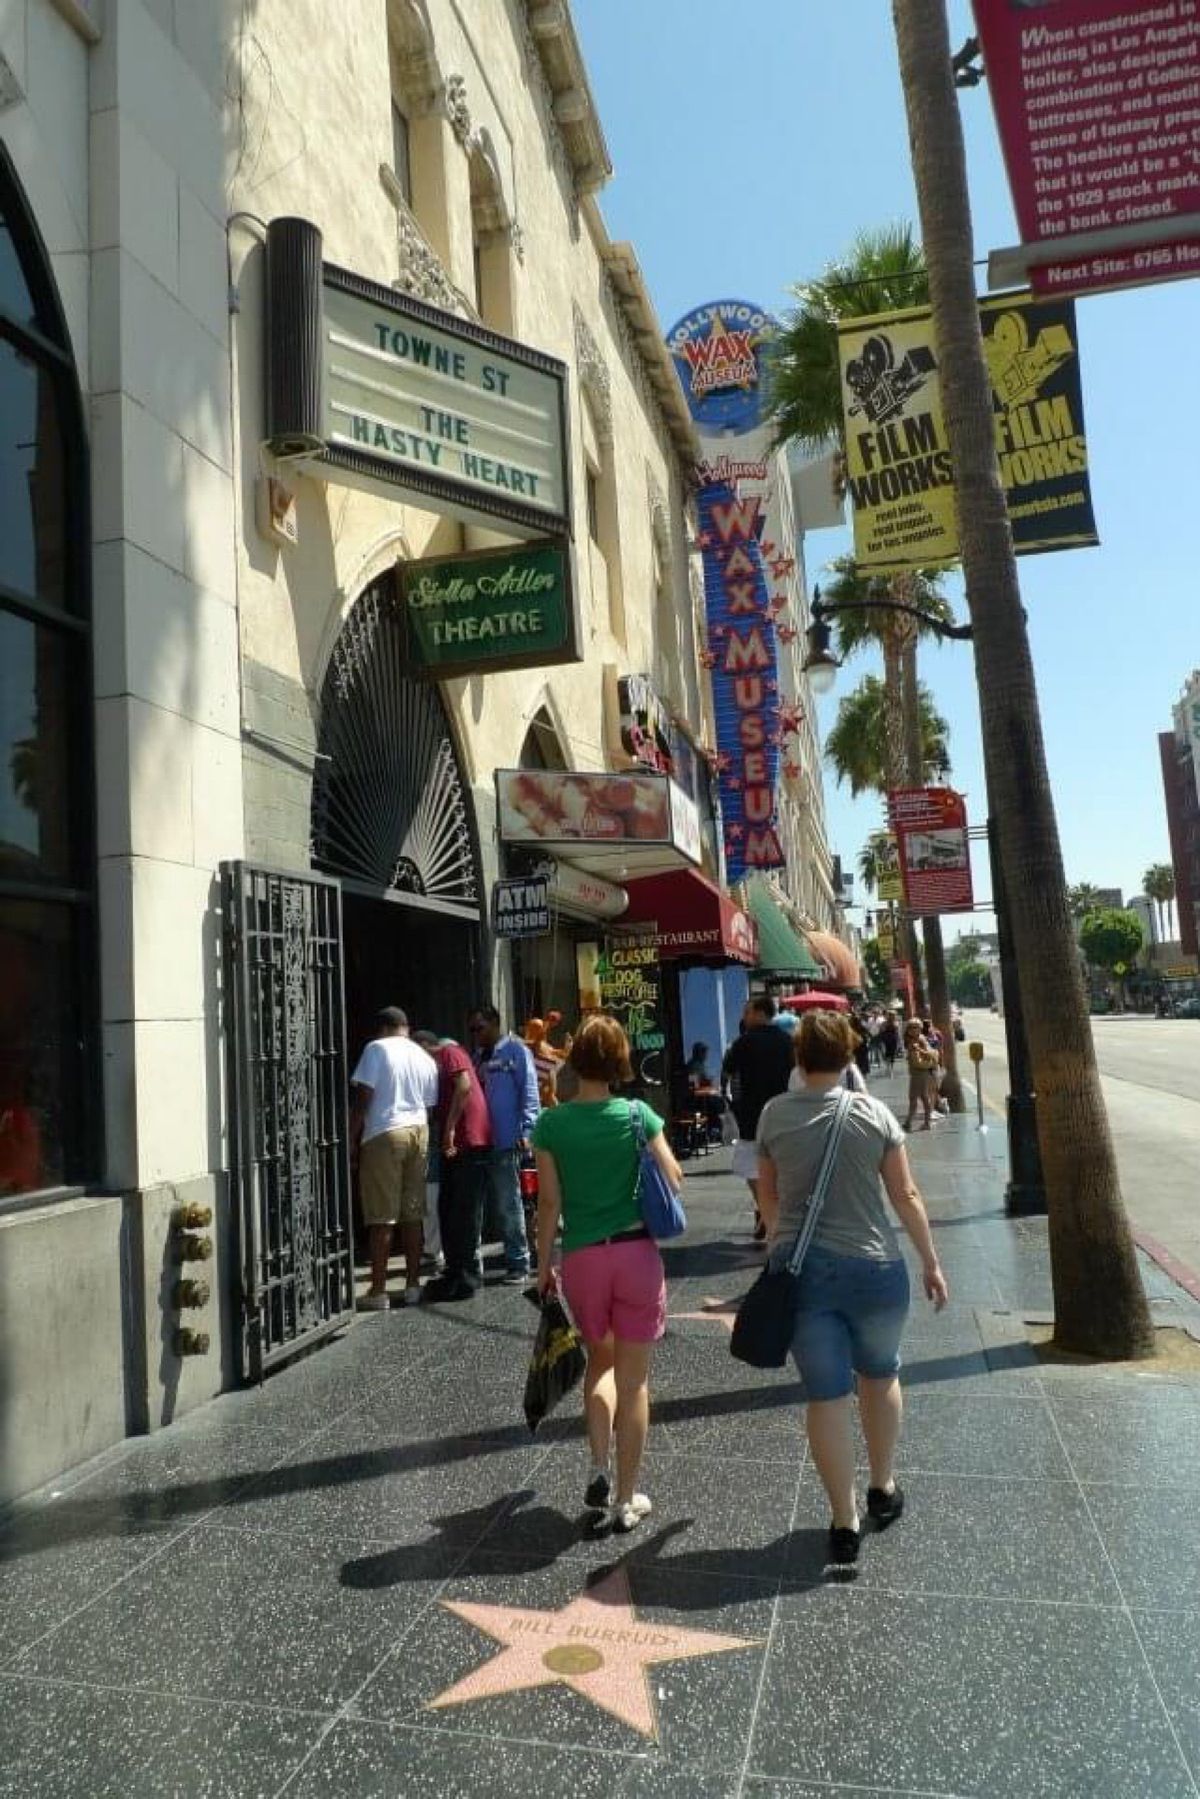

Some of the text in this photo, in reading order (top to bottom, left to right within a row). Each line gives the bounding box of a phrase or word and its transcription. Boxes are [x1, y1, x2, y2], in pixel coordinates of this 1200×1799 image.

[1023, 0, 1195, 47] When constructed in
[1023, 46, 1087, 69] building
[1093, 39, 1107, 54] in
[1113, 35, 1139, 50] Los
[1083, 59, 1115, 77] also
[1122, 42, 1196, 69] designed
[1027, 80, 1123, 109] combination
[1129, 75, 1143, 89] of
[1123, 93, 1151, 111] and
[1031, 134, 1075, 150] sense
[1083, 126, 1097, 141] of
[1102, 117, 1159, 137] fantasy
[1033, 156, 1061, 172] The
[1068, 143, 1132, 165] beehive
[1139, 132, 1186, 151] above
[1035, 176, 1065, 192] that
[1072, 172, 1082, 187] it
[1087, 161, 1137, 182] would
[1145, 158, 1162, 172] be
[1170, 156, 1179, 168] a
[1039, 198, 1062, 214] the
[1069, 189, 1102, 207] 1929
[1108, 179, 1151, 199] stock
[1041, 198, 1175, 234] the bank closed.
[1049, 264, 1087, 283] Next
[1094, 259, 1129, 277] Site:
[1135, 249, 1171, 269] 6765
[374, 322, 510, 398] TOWNE ST
[683, 330, 757, 372] WAX
[691, 363, 758, 393] MUSEUM
[420, 404, 468, 446] THE
[992, 394, 1074, 452] FILM
[352, 415, 540, 499] HASTY HEART
[857, 411, 938, 472] FILM
[846, 451, 954, 511] WORKS
[710, 497, 764, 616] WAX
[430, 610, 543, 647] THEATRE
[723, 626, 786, 867] MUSEUM
[498, 884, 547, 912] ATM
[498, 912, 548, 931] INSIDE
[612, 948, 659, 967] CLASSIC
[615, 970, 642, 985] DOG
[508, 1618, 555, 1637] BILL
